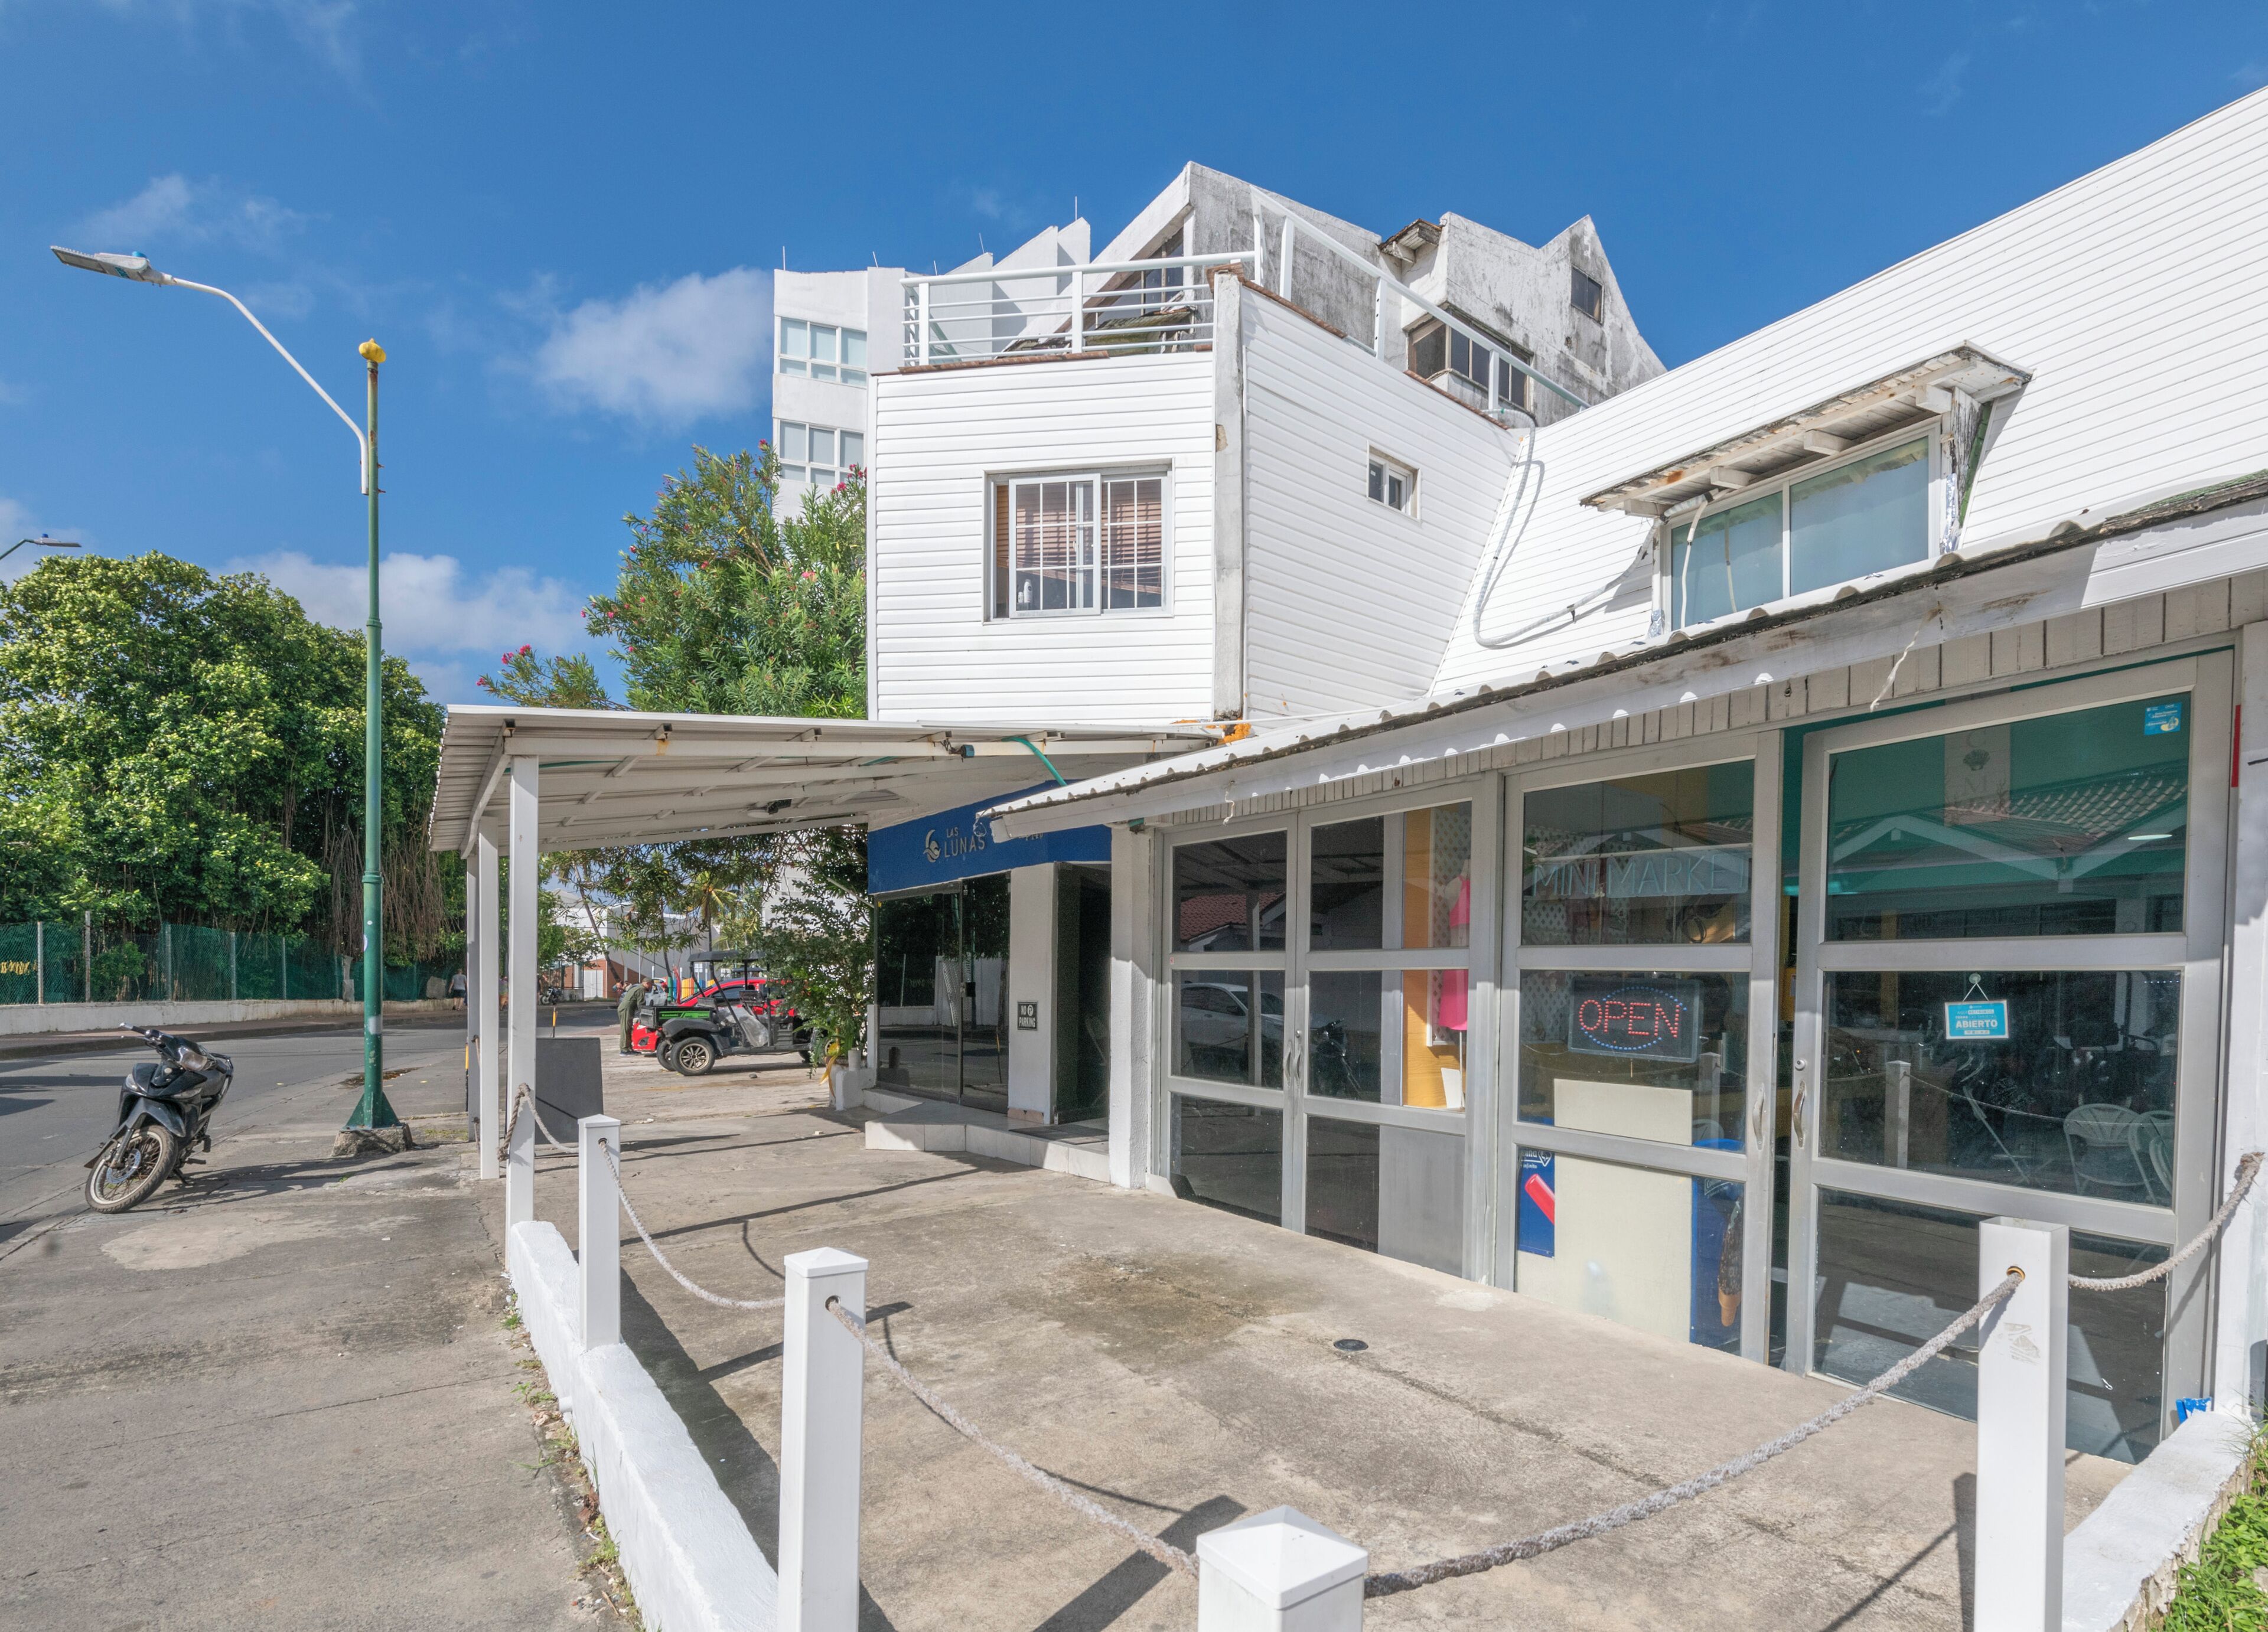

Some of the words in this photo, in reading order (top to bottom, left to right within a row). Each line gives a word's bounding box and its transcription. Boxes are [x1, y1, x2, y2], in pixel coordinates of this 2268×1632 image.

[946, 827, 959, 838] LAS
[944, 835, 985, 858] LUNAS
[1533, 863, 1597, 896] MINI
[1608, 854, 1748, 895] MARKET
[1021, 1005, 1027, 1016] NO
[1019, 1017, 1035, 1027] PARKING
[1578, 999, 1680, 1038] OPEN
[1956, 1020, 1998, 1029] ABIERTO
